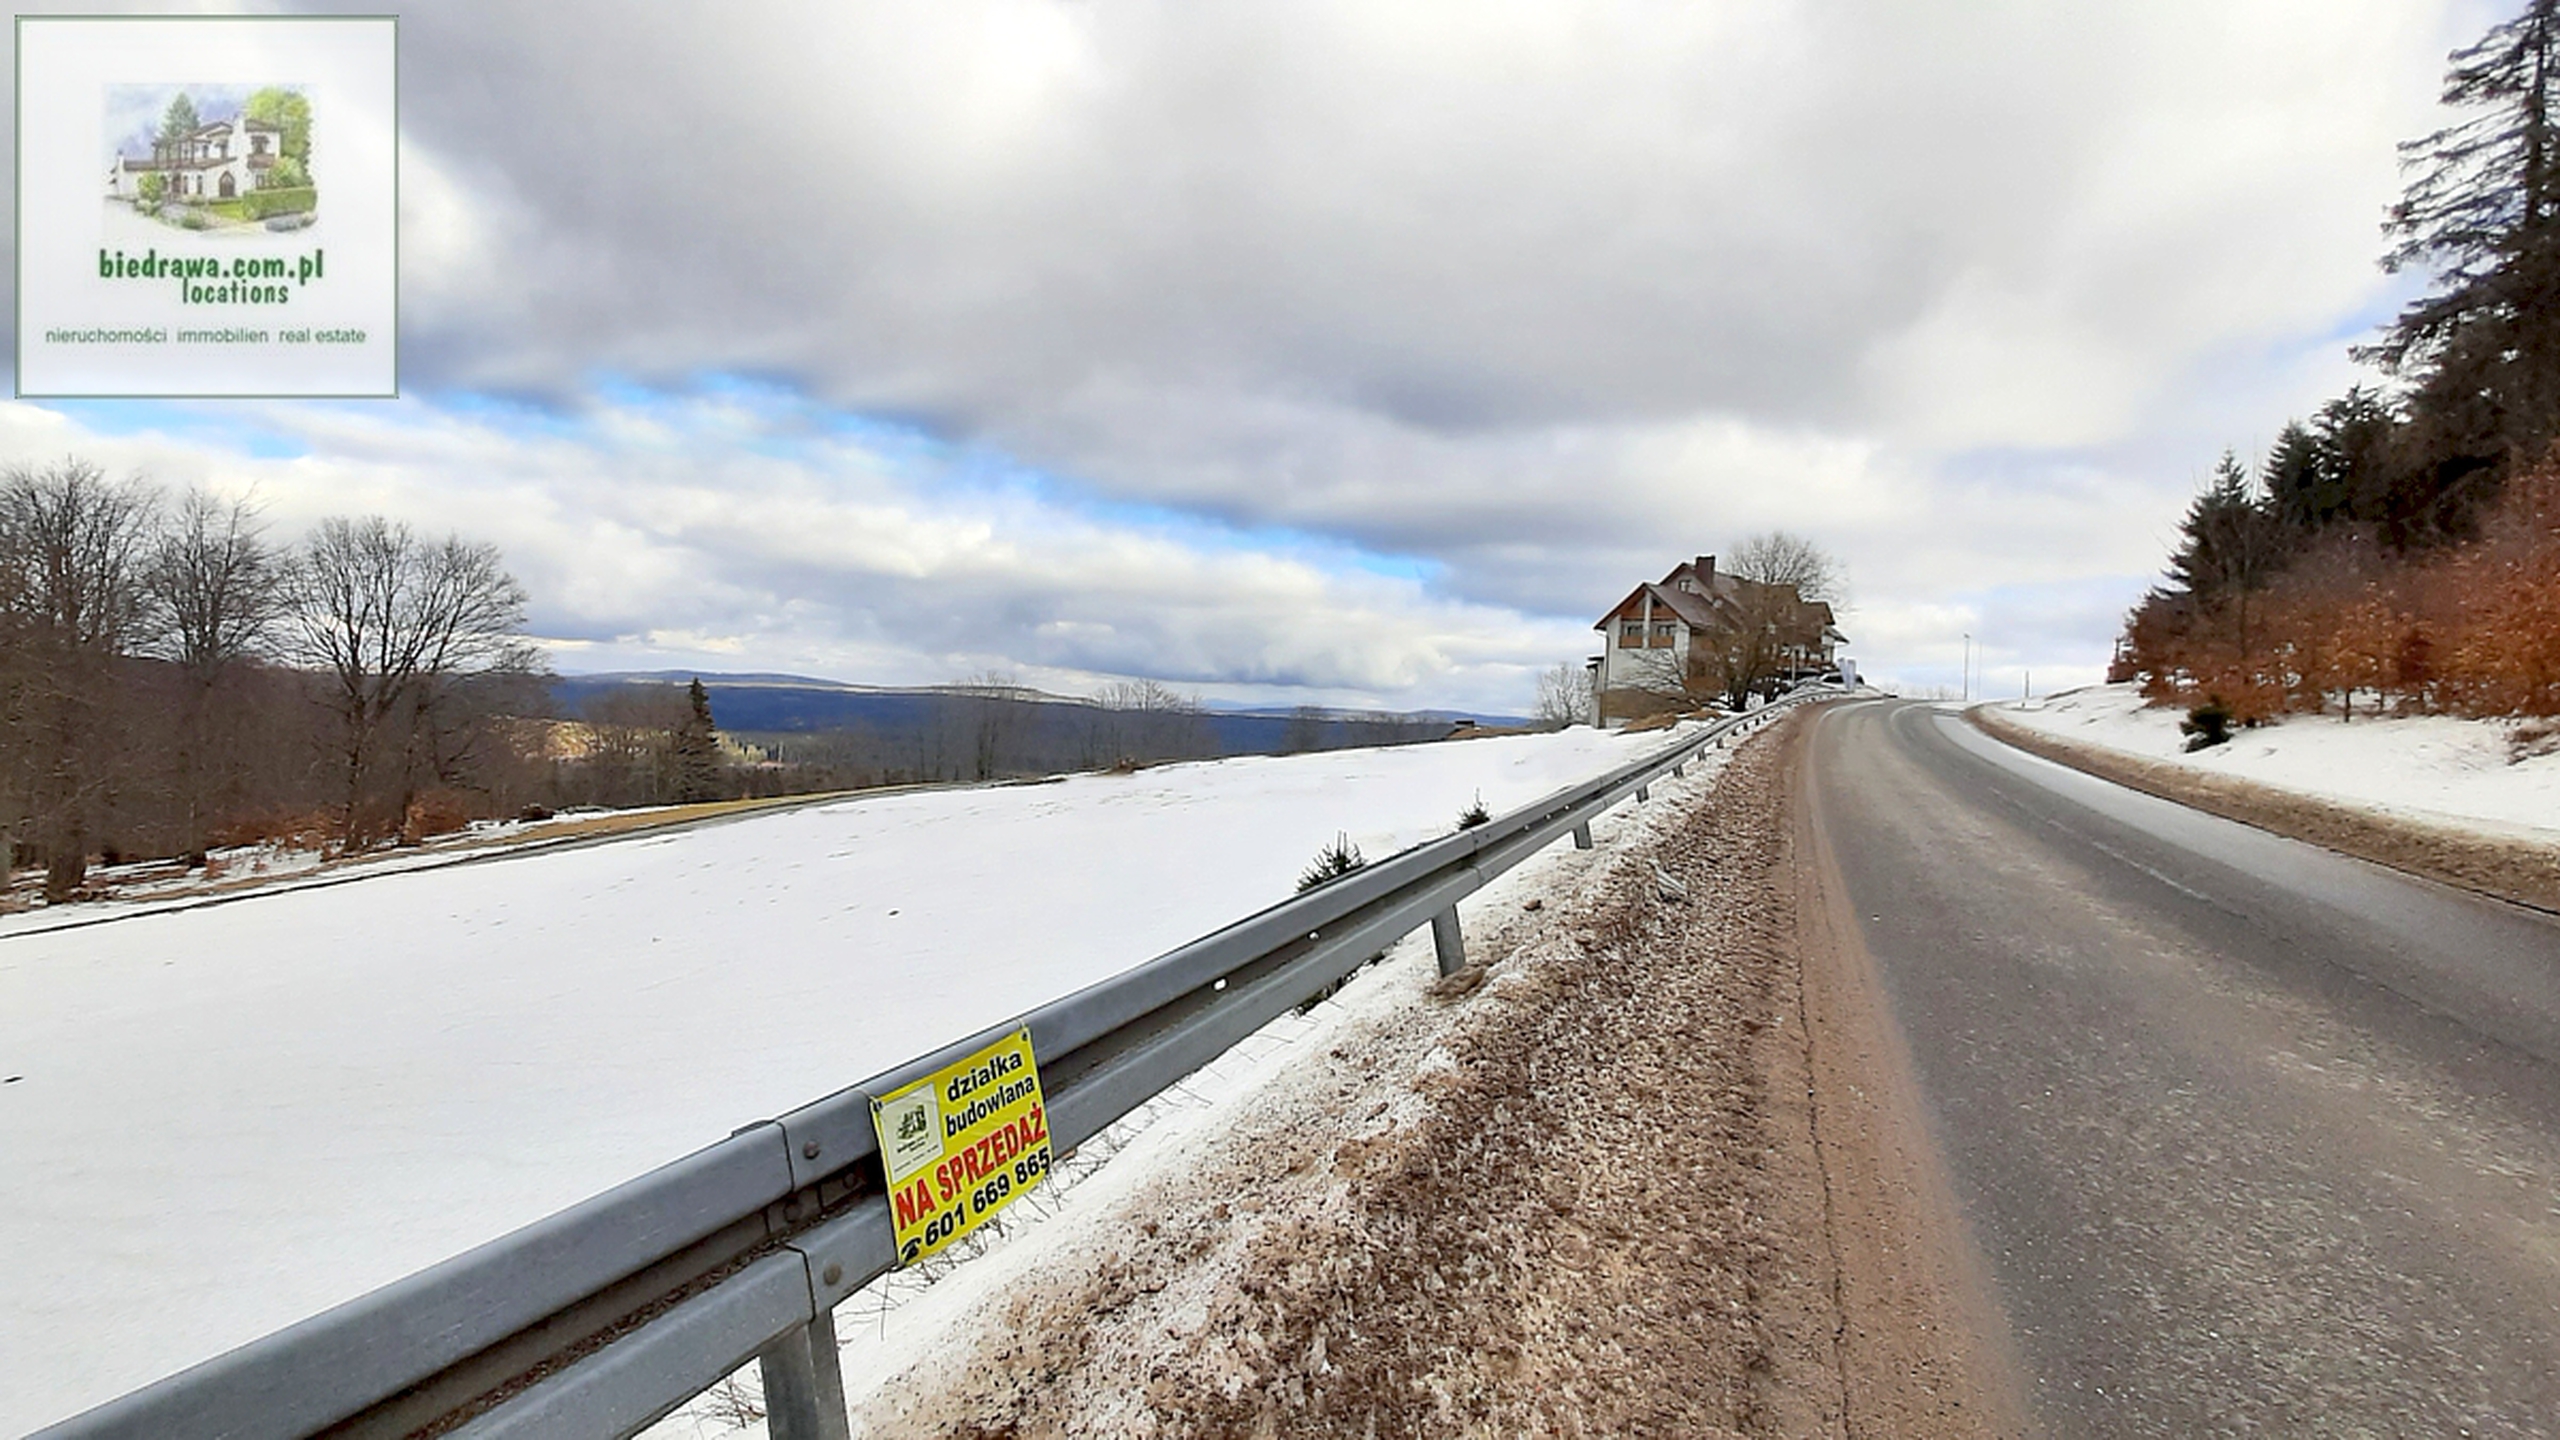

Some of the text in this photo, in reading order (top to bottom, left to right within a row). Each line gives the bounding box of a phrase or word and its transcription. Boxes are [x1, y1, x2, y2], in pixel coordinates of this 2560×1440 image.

[946, 1075, 1035, 1138] budowlana
[947, 1052, 1022, 1102] działka
[895, 1103, 1046, 1231] NA SPRZEDAŻ
[925, 1147, 1050, 1248] 601 669 865
